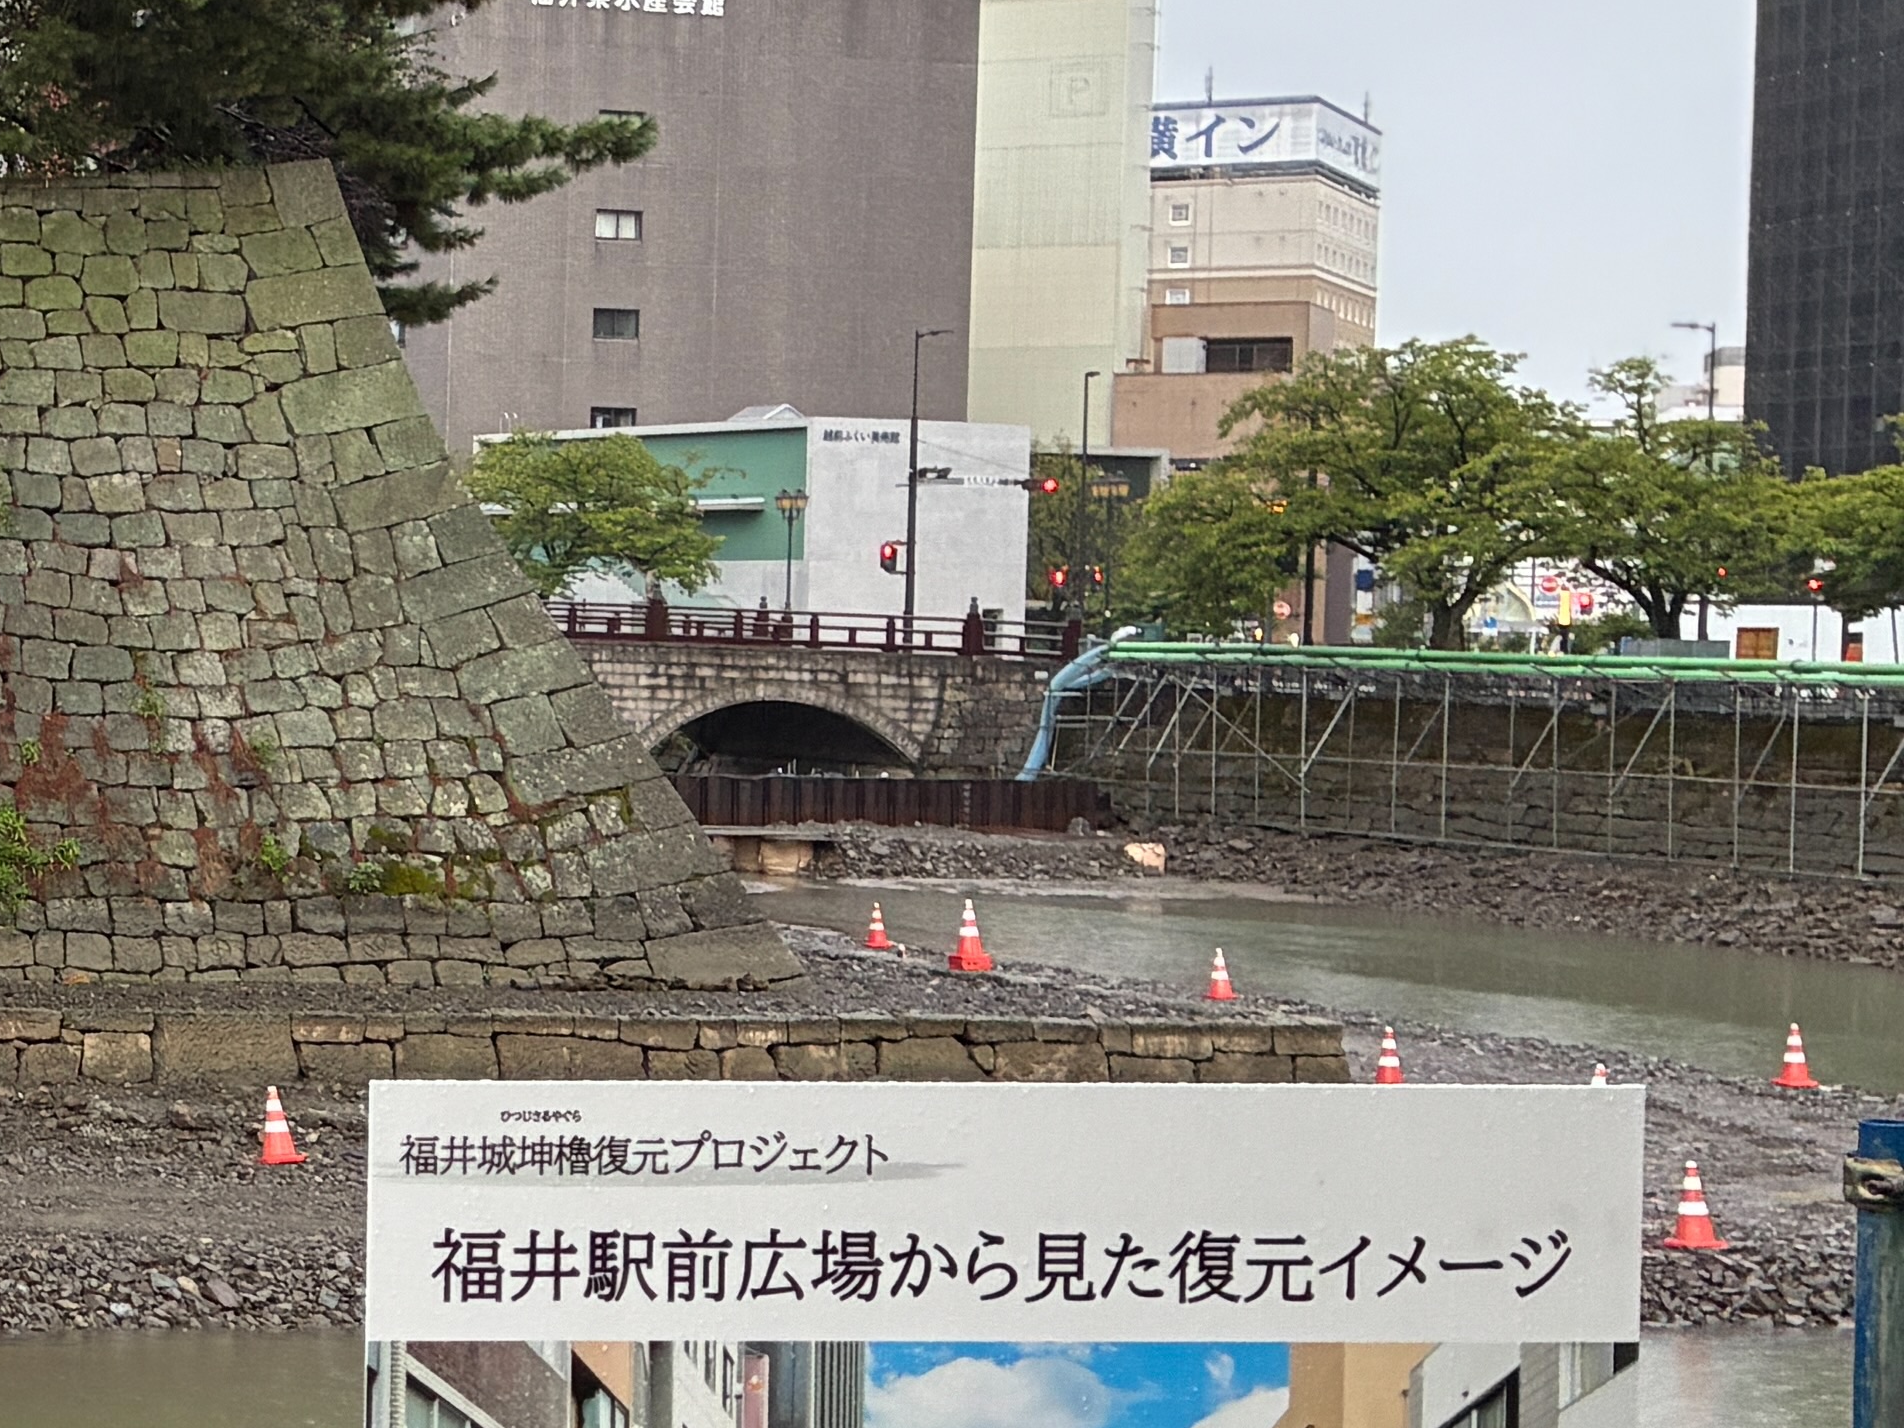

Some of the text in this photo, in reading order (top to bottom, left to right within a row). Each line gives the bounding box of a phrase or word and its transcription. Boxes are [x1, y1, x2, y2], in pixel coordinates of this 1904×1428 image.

[399, 1130, 889, 1176] 福井城坤櫓復元プロジェクト
[430, 1227, 1571, 1304] 福井駅前広場から見た復元イメージ
